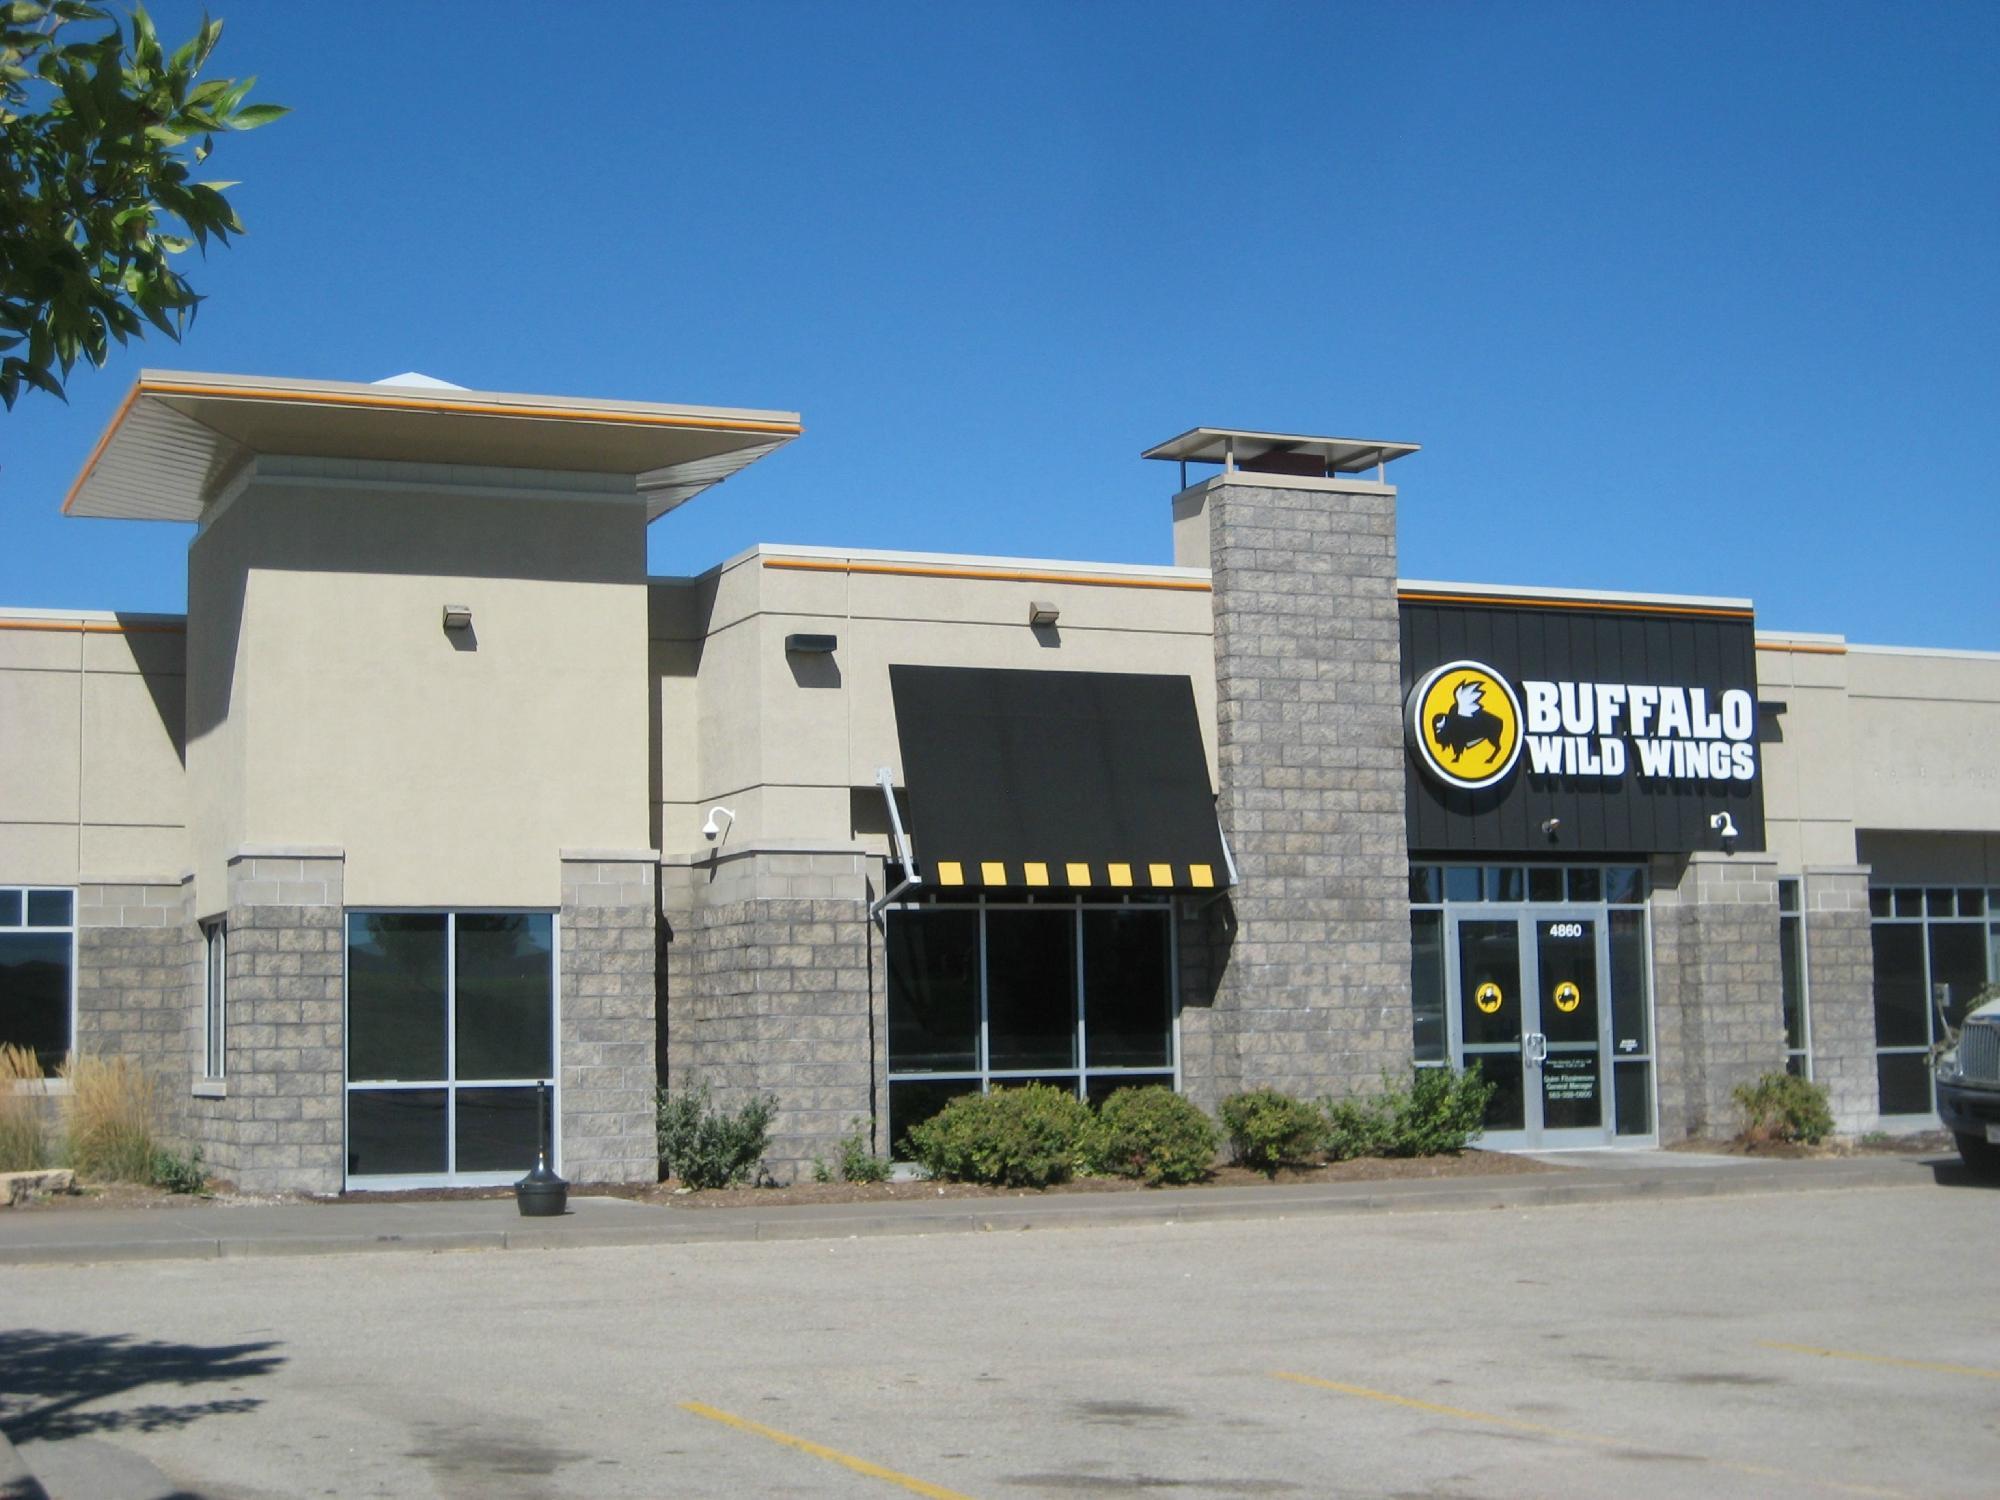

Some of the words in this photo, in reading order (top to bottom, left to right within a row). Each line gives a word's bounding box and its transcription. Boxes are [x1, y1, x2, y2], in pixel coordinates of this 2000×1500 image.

[1522, 681, 1753, 740] BUFFALO
[1525, 735, 1625, 776] WILD
[1635, 739, 1755, 780] WINGS
[1550, 924, 1582, 937] 4860
